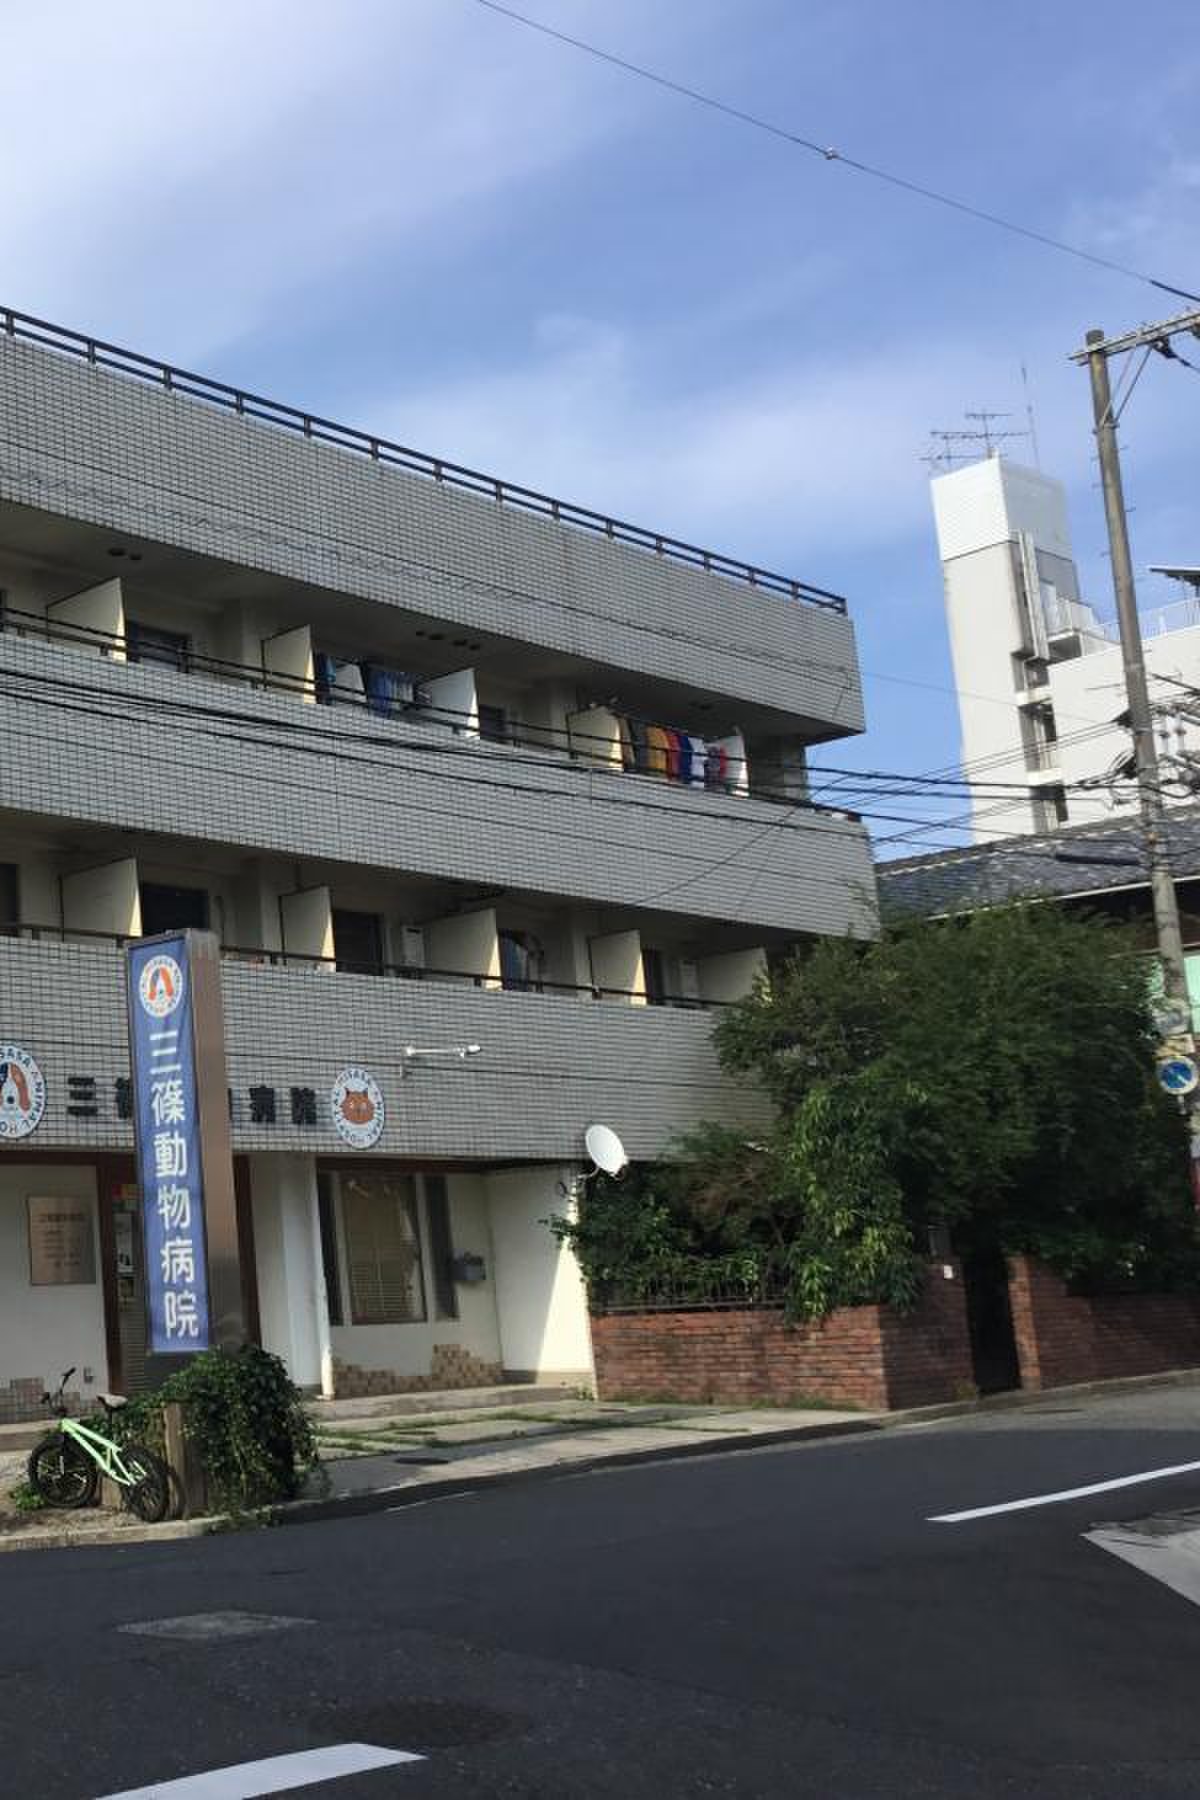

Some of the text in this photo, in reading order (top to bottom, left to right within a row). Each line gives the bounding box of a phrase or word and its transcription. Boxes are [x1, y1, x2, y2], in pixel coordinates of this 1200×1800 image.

[149, 1029, 199, 1338] 三篠動物病院
